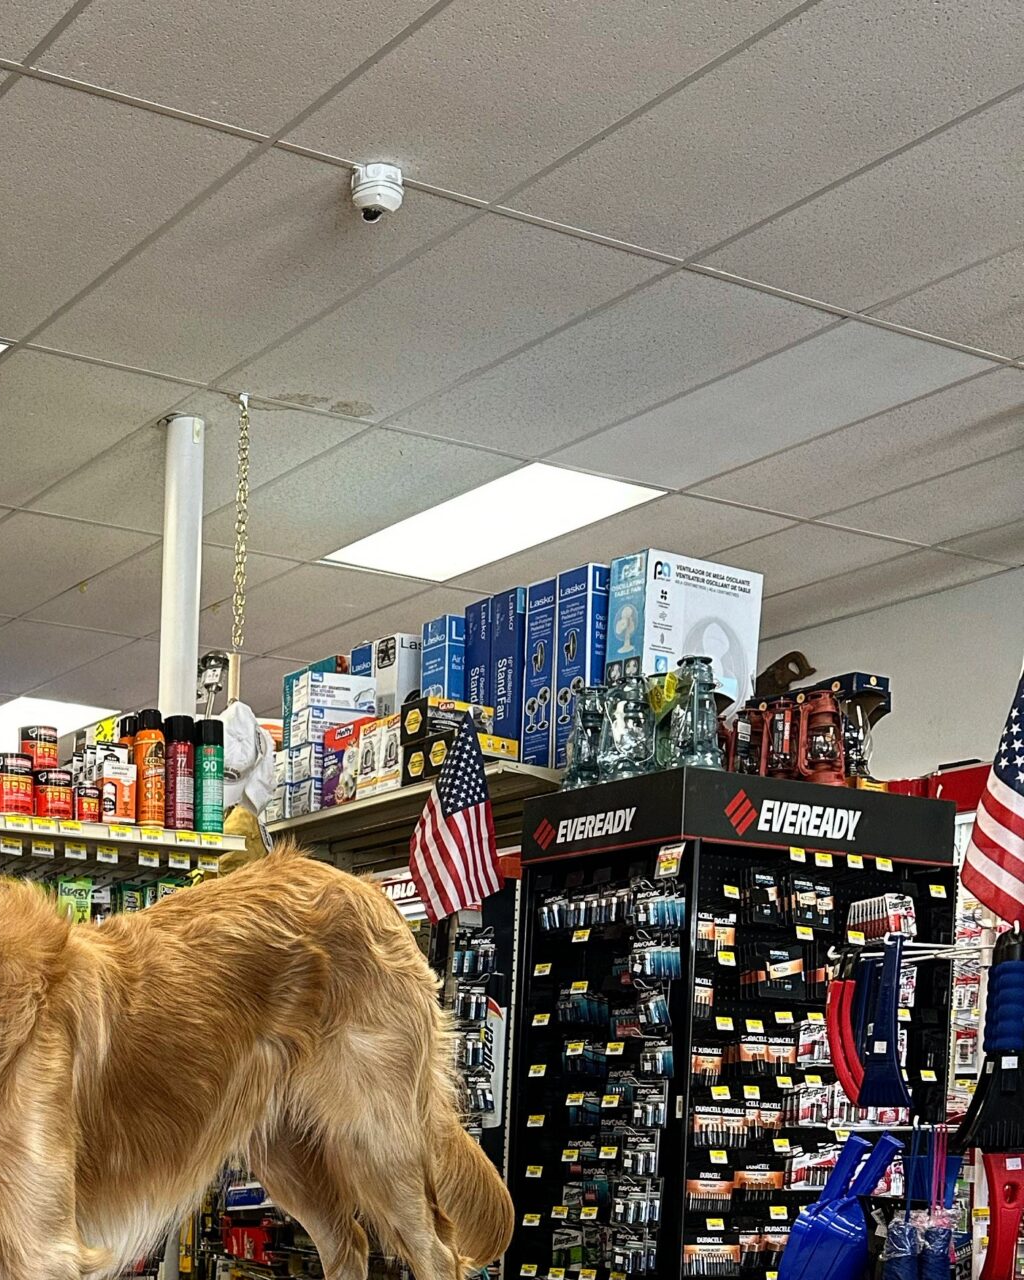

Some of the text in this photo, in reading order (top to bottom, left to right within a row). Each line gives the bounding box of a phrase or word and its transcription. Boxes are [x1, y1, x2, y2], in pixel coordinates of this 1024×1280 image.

[560, 582, 586, 597] Lasko
[529, 595, 554, 609] Lasko
[423, 632, 446, 648] Lasko
[352, 662, 371, 674] Lasko
[470, 667, 479, 703] Stand
[497, 658, 507, 721] Stand Fan
[177, 757, 187, 767] 77
[203, 761, 217, 772] 90
[555, 807, 637, 844] EVEREADY
[757, 799, 862, 841] EVEREADY
[637, 890, 661, 899] RAYOVAC
[888, 900, 912, 910] Energizer
[633, 940, 658, 948] RAYOVAC
[696, 1105, 721, 1113] DURACELL
